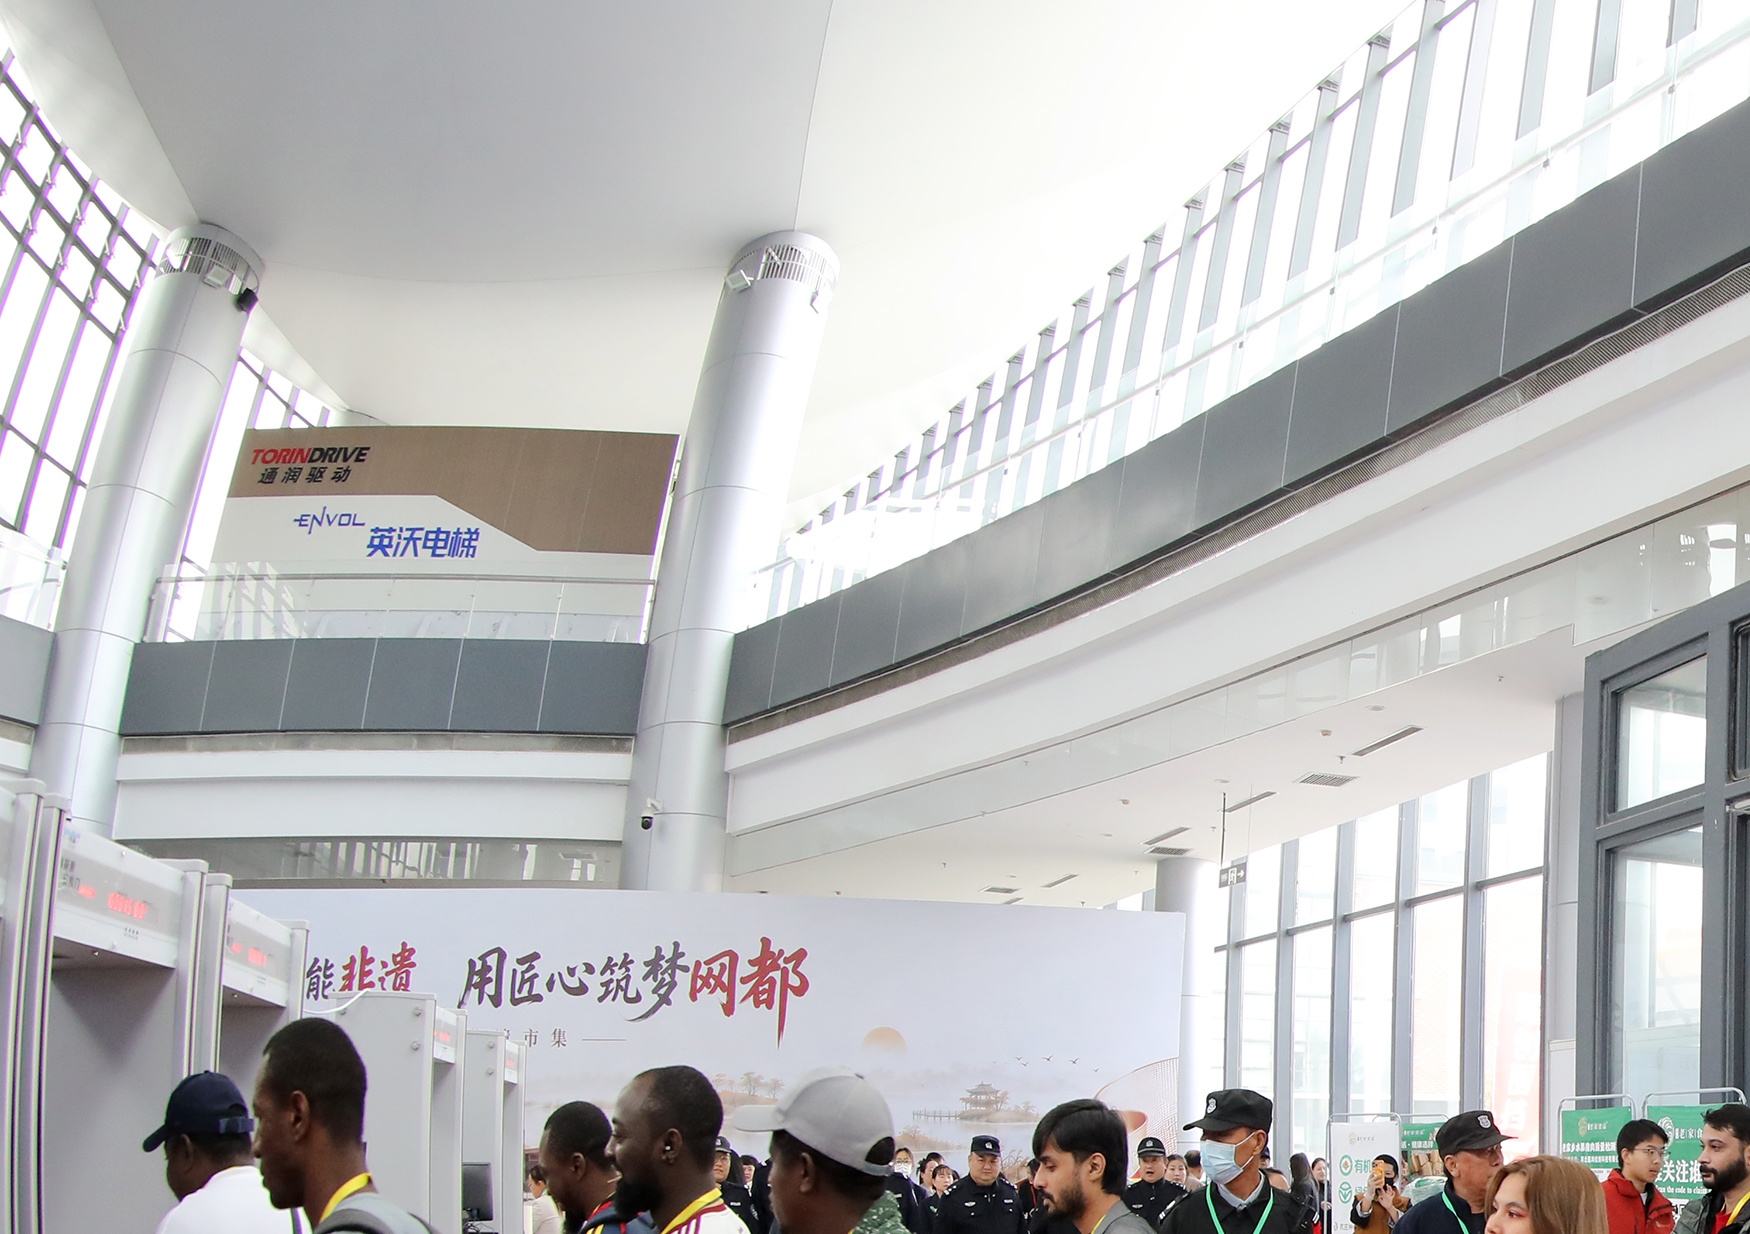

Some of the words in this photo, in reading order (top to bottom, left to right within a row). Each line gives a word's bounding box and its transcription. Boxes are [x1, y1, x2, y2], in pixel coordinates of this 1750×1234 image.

[251, 446, 370, 466] TORINDRIVE
[257, 465, 351, 485] 通润驱动
[293, 505, 366, 534] ENVOL
[366, 526, 480, 559] 英沃电梯
